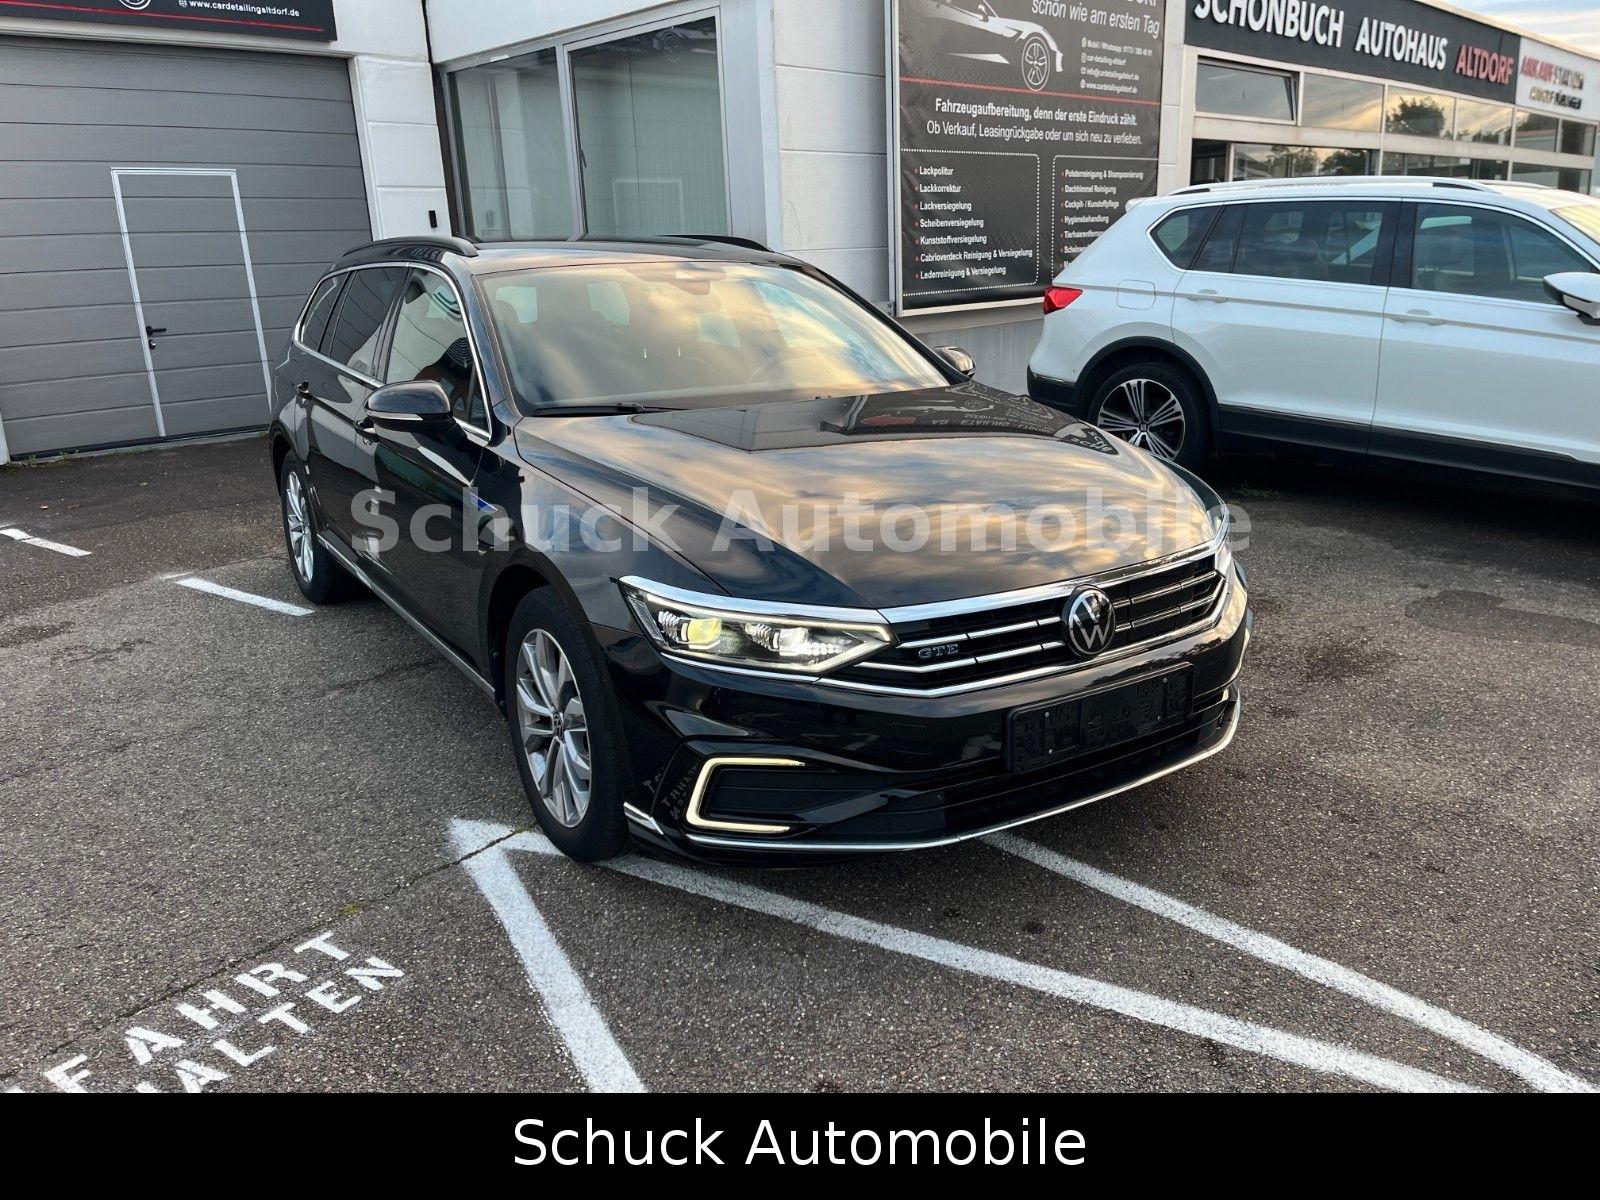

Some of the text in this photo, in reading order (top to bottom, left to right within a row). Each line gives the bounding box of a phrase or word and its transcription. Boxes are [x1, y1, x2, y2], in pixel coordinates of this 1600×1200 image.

[189, 0, 300, 17] www.cardetailingaltdorf.de
[1069, 2, 1087, 22] wie
[1090, 9, 1107, 26] am
[1109, 11, 1140, 31] ersten
[1143, 15, 1160, 39] Tag
[1355, 17, 1448, 71] AUTOHAUS
[1455, 44, 1514, 85] ALTDORF
[935, 98, 1032, 121] Fahrzeugaufbereitung,
[1033, 106, 1053, 120] denn
[1055, 108, 1068, 121] der
[1069, 110, 1087, 122] erste
[1088, 110, 1119, 124] Eindruck
[927, 120, 941, 134] Ob
[942, 121, 977, 138] Verkauf,
[979, 123, 1044, 142] Leasingrückgabe
[1045, 129, 1061, 141] oder
[1063, 132, 1074, 141] um
[1075, 130, 1089, 142] sich
[1090, 134, 1103, 143] neu
[1103, 134, 1112, 143] zu
[919, 166, 954, 177] Lackpolitur
[919, 184, 962, 193] Lackkorrektur
[920, 201, 972, 212] Lackversiegelung
[920, 218, 984, 229] Scheibenversiegelung
[920, 234, 987, 245] Kunststoffversiegelung
[920, 251, 962, 262] Cabrioverdeck
[964, 250, 992, 261] Reinigung
[998, 247, 1033, 258] Versiegelung
[920, 265, 1007, 280] Lederreinigung & Versiegelung
[917, 643, 959, 660] GTE
